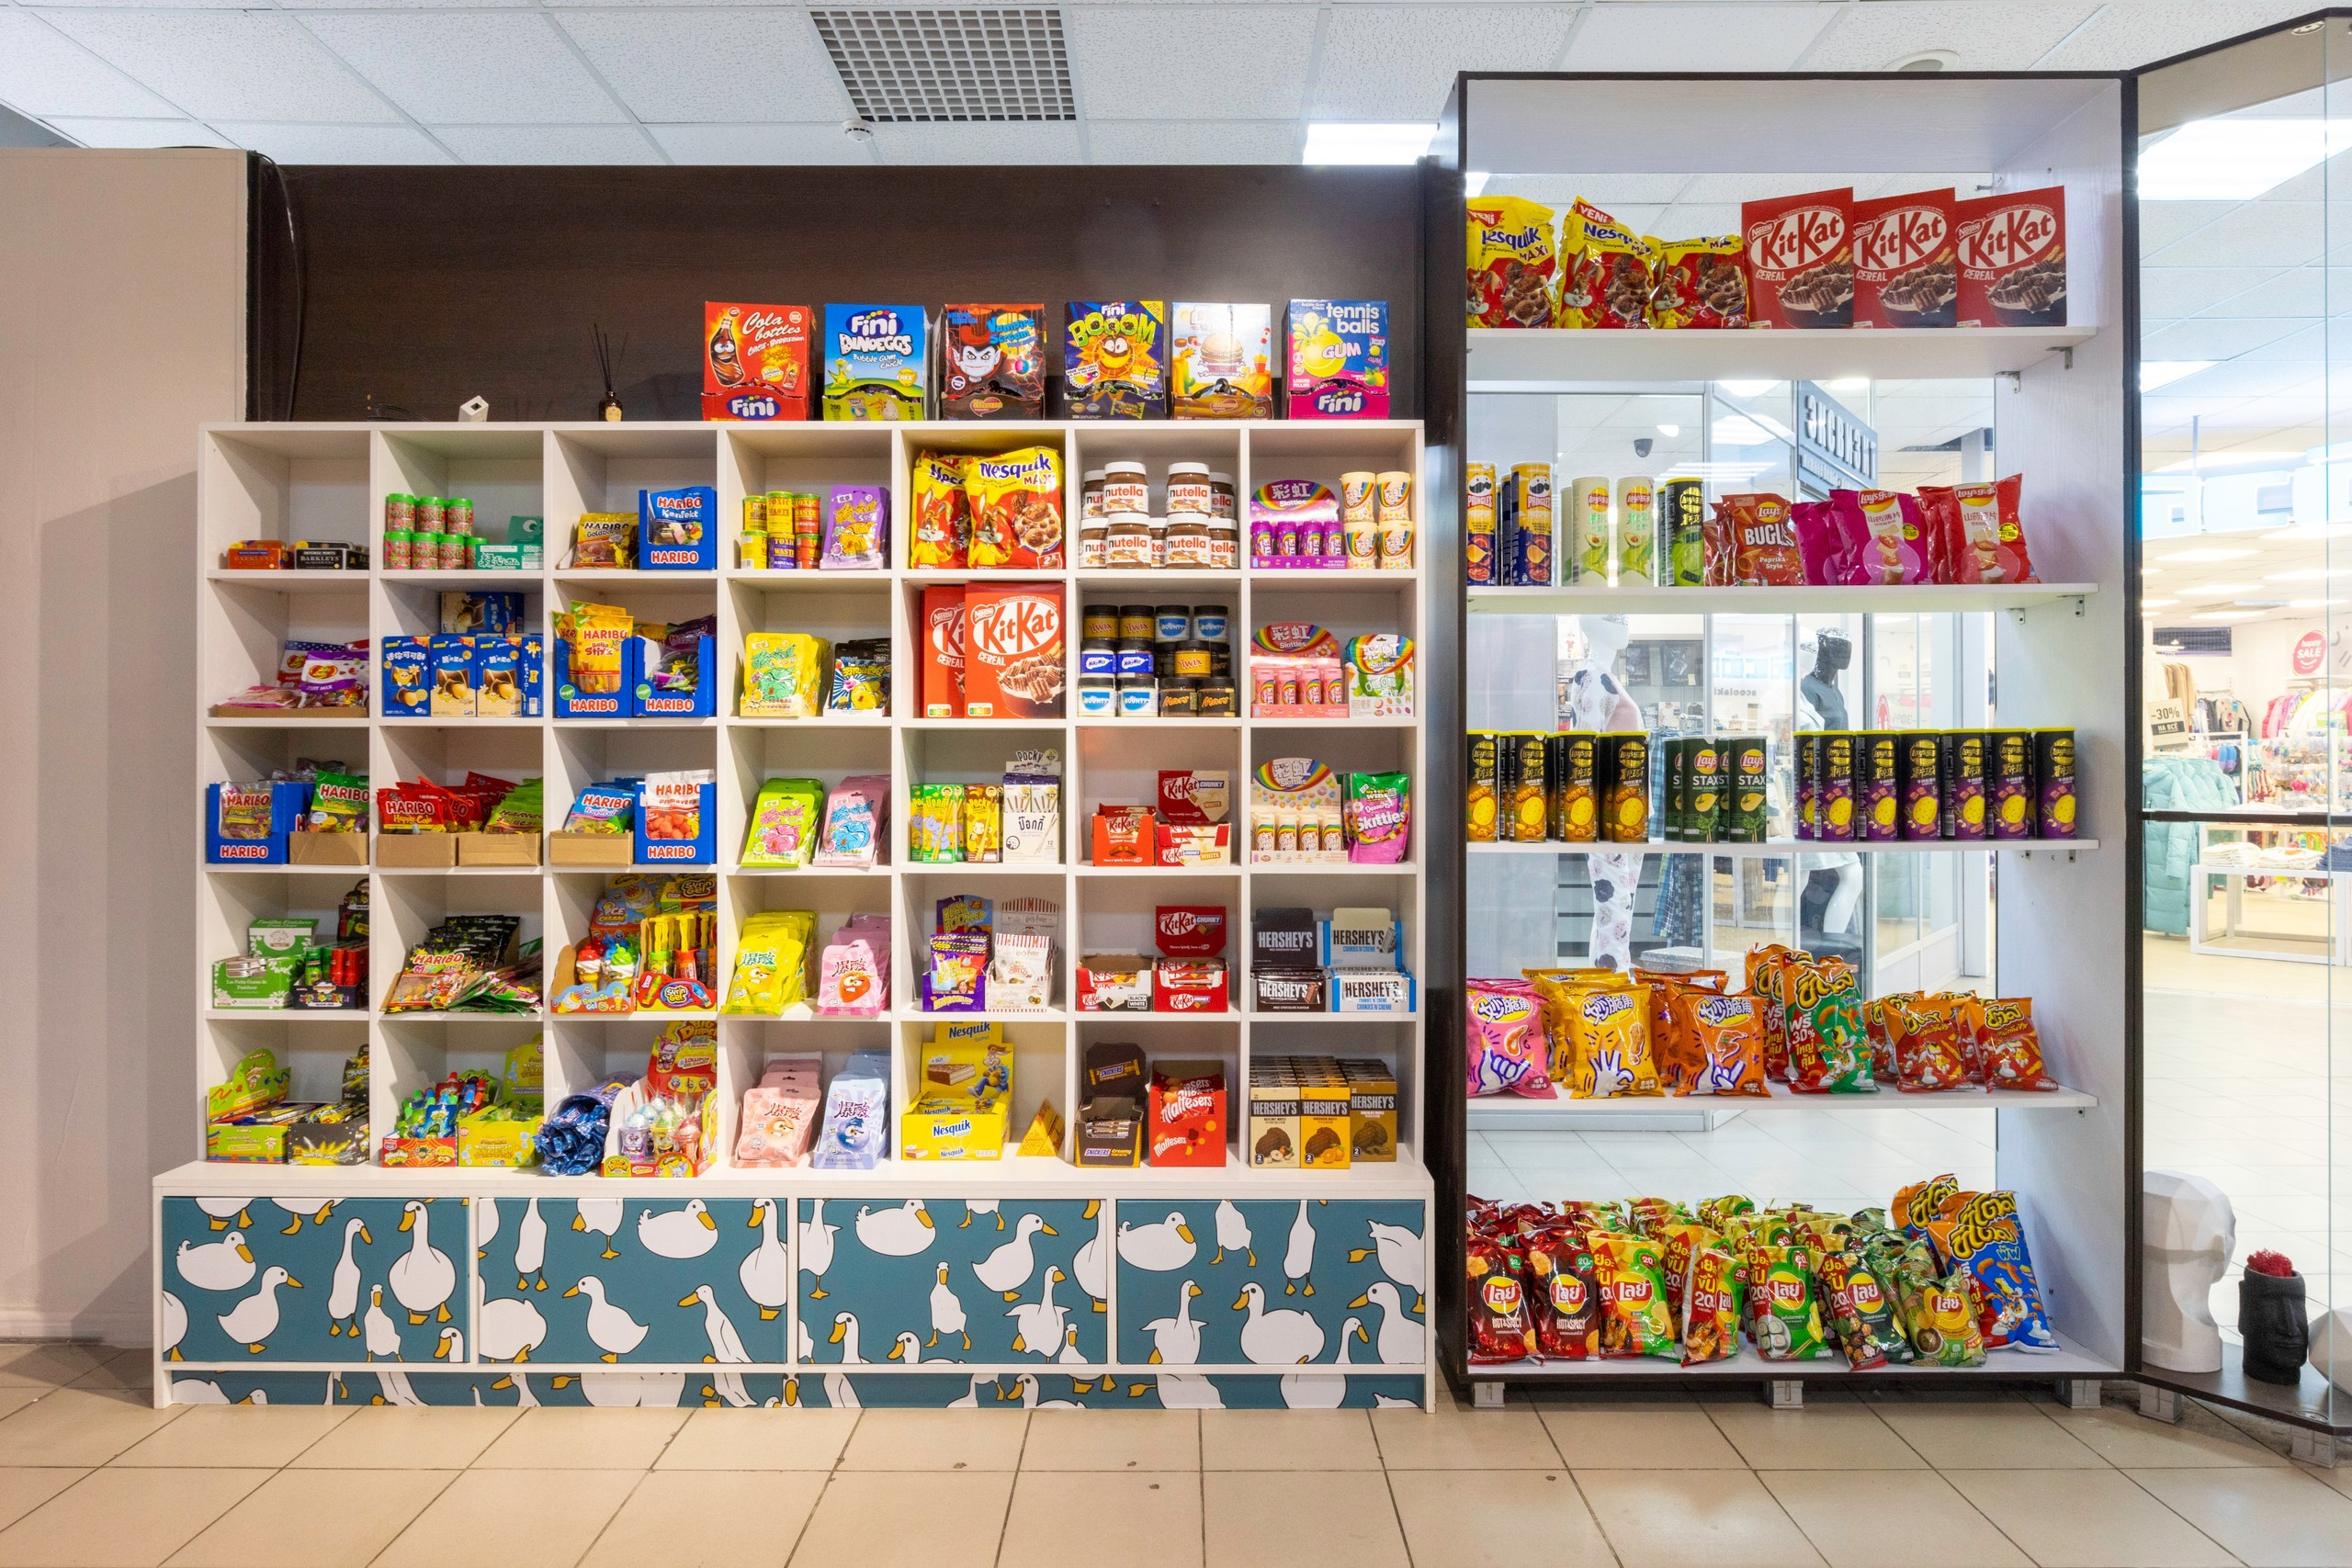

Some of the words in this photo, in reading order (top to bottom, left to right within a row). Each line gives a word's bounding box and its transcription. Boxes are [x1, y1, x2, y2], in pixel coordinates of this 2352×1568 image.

[1759, 210, 1841, 269] KitKat
[1861, 210, 1942, 269] KitKat
[1968, 209, 2052, 268] KitKat
[1755, 268, 1787, 282] CEREAL
[1856, 268, 1888, 282] CEREAL
[1963, 267, 1996, 281] CEREAL
[1101, 302, 1125, 317] Fini
[1326, 302, 1380, 320] tennis
[742, 311, 785, 335] Cola
[851, 312, 898, 336] Fini
[986, 316, 1035, 333] Vampire
[1068, 311, 1157, 348] BOOOM
[1336, 318, 1380, 334] balls
[754, 323, 802, 342] bottles
[989, 329, 1031, 345] Scream
[838, 333, 913, 356] DINOEGGS
[1321, 342, 1363, 360] GUM
[731, 396, 775, 417] Fini
[1317, 391, 1363, 413] Fini
[979, 453, 1053, 479] Nesquik
[1104, 484, 1144, 499] nutella
[1169, 485, 1208, 499] nutella
[1271, 482, 1311, 499] 彩虹
[656, 497, 703, 510] HARIBO
[1467, 496, 1492, 508] PRINGLES
[1758, 505, 1781, 521] Lay's
[1108, 535, 1148, 548] nutella
[1168, 536, 1207, 549] nutella
[650, 550, 699, 564] HARIBO
[582, 628, 628, 640] HARIBO
[982, 601, 1056, 654] KitKat
[1089, 622, 1113, 633] Twix
[1125, 622, 1148, 633] Twix
[1160, 623, 1187, 631] BOUNTY
[977, 650, 1007, 667] CEREAL
[2296, 646, 2323, 660] SALE
[1179, 657, 1204, 669] Twix
[569, 698, 618, 712] HARIBO
[646, 698, 695, 712] HARIBO
[1083, 696, 1109, 705] BOUNTY
[1124, 696, 1149, 705] BOUNTY
[1162, 694, 1189, 707] Mars
[1202, 694, 1229, 707] Mars
[2151, 706, 2181, 721] -30%
[2157, 724, 2166, 732] НА
[1697, 755, 1718, 768] Lay's
[1742, 755, 1764, 768] Lay's
[1279, 778, 1307, 787] Skittles
[1692, 775, 1719, 785] STAX
[1738, 775, 1766, 785] STAX
[319, 784, 369, 803] HARIBO
[1168, 777, 1198, 799] KitKat
[225, 794, 270, 807] HARIBO
[385, 800, 435, 815] HARIBO
[582, 794, 632, 809] HARIBO
[1108, 817, 1136, 834] KitKat
[1357, 810, 1406, 833] Skittles
[220, 845, 269, 859] HARIBO
[648, 846, 696, 860] HARIBO
[1165, 848, 1184, 862] KitKat
[1200, 852, 1220, 860] WHITE
[943, 899, 968, 919] BEAN
[1164, 913, 1195, 935] KitKat
[1258, 931, 1314, 949] HERSHEY'S
[1333, 930, 1385, 946] HERSHEY'S
[413, 953, 464, 965] HARIBO
[1260, 982, 1308, 998] HERSHEY'S
[1084, 994, 1101, 1006] KitKat
[1172, 994, 1194, 1009] KitKat
[1476, 996, 1532, 1025] 妙脆角
[1584, 994, 1634, 1026] 妙脆角
[1698, 997, 1754, 1027] 妙脆角
[1789, 1010, 1813, 1032] ฟรี
[948, 1021, 991, 1039] Nesquik
[1792, 1028, 1815, 1044] 30%
[1795, 1039, 1815, 1055] ใหญ่
[1801, 1054, 1815, 1070] คุ้ม
[1100, 1066, 1124, 1077] SNICKERS
[924, 1105, 951, 1115] Nesquik
[1160, 1095, 1214, 1124] Maltesers
[1252, 1101, 1297, 1115] HERSHEY'S
[1303, 1100, 1348, 1115] HERSHEY'S
[1351, 1095, 1395, 1110] HERSHEY'S
[933, 1119, 972, 1137] Nesquik
[940, 1147, 965, 1158] Nesquik
[1153, 1135, 1187, 1157] Maltesers
[1489, 1282, 1516, 1304] เลย์
[1619, 1278, 1647, 1302] เลย์
[1773, 1279, 1801, 1300] เลย์
[1853, 1280, 1880, 1304] เลย์
[1936, 1295, 1961, 1313] เลย์
